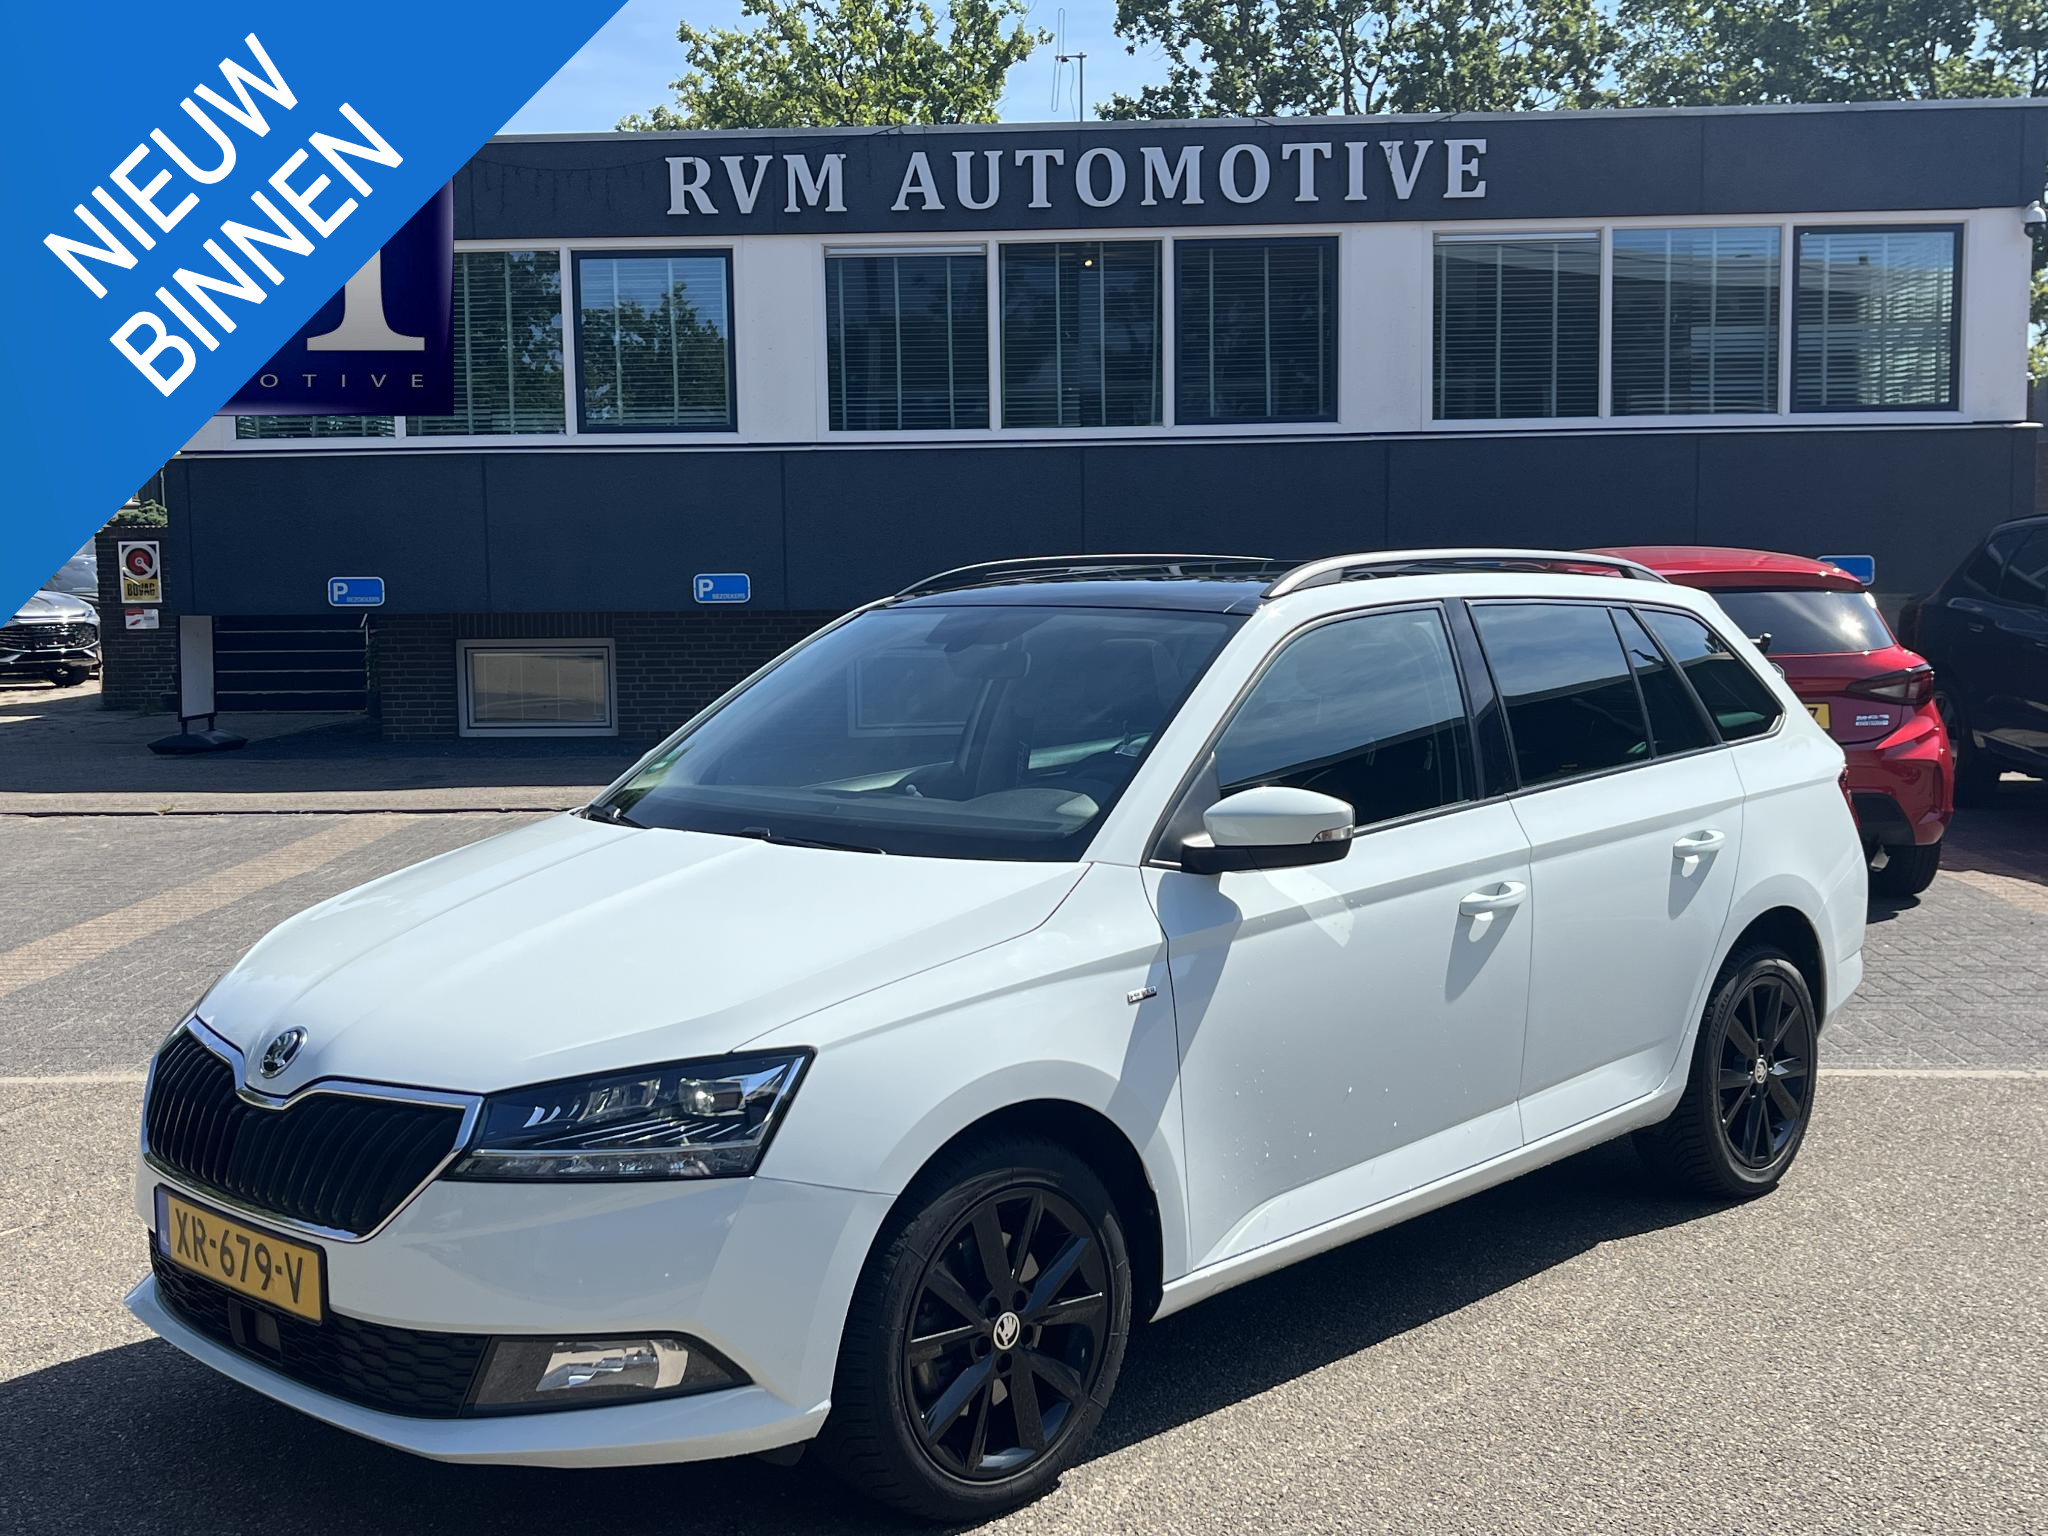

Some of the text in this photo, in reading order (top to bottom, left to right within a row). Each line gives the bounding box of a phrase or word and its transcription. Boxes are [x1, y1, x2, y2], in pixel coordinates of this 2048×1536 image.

[665, 138, 1487, 215] RVM AUTOMOTIVE
[333, 582, 349, 601] P
[697, 579, 714, 598] P
[175, 1207, 303, 1304] XR-679-V
